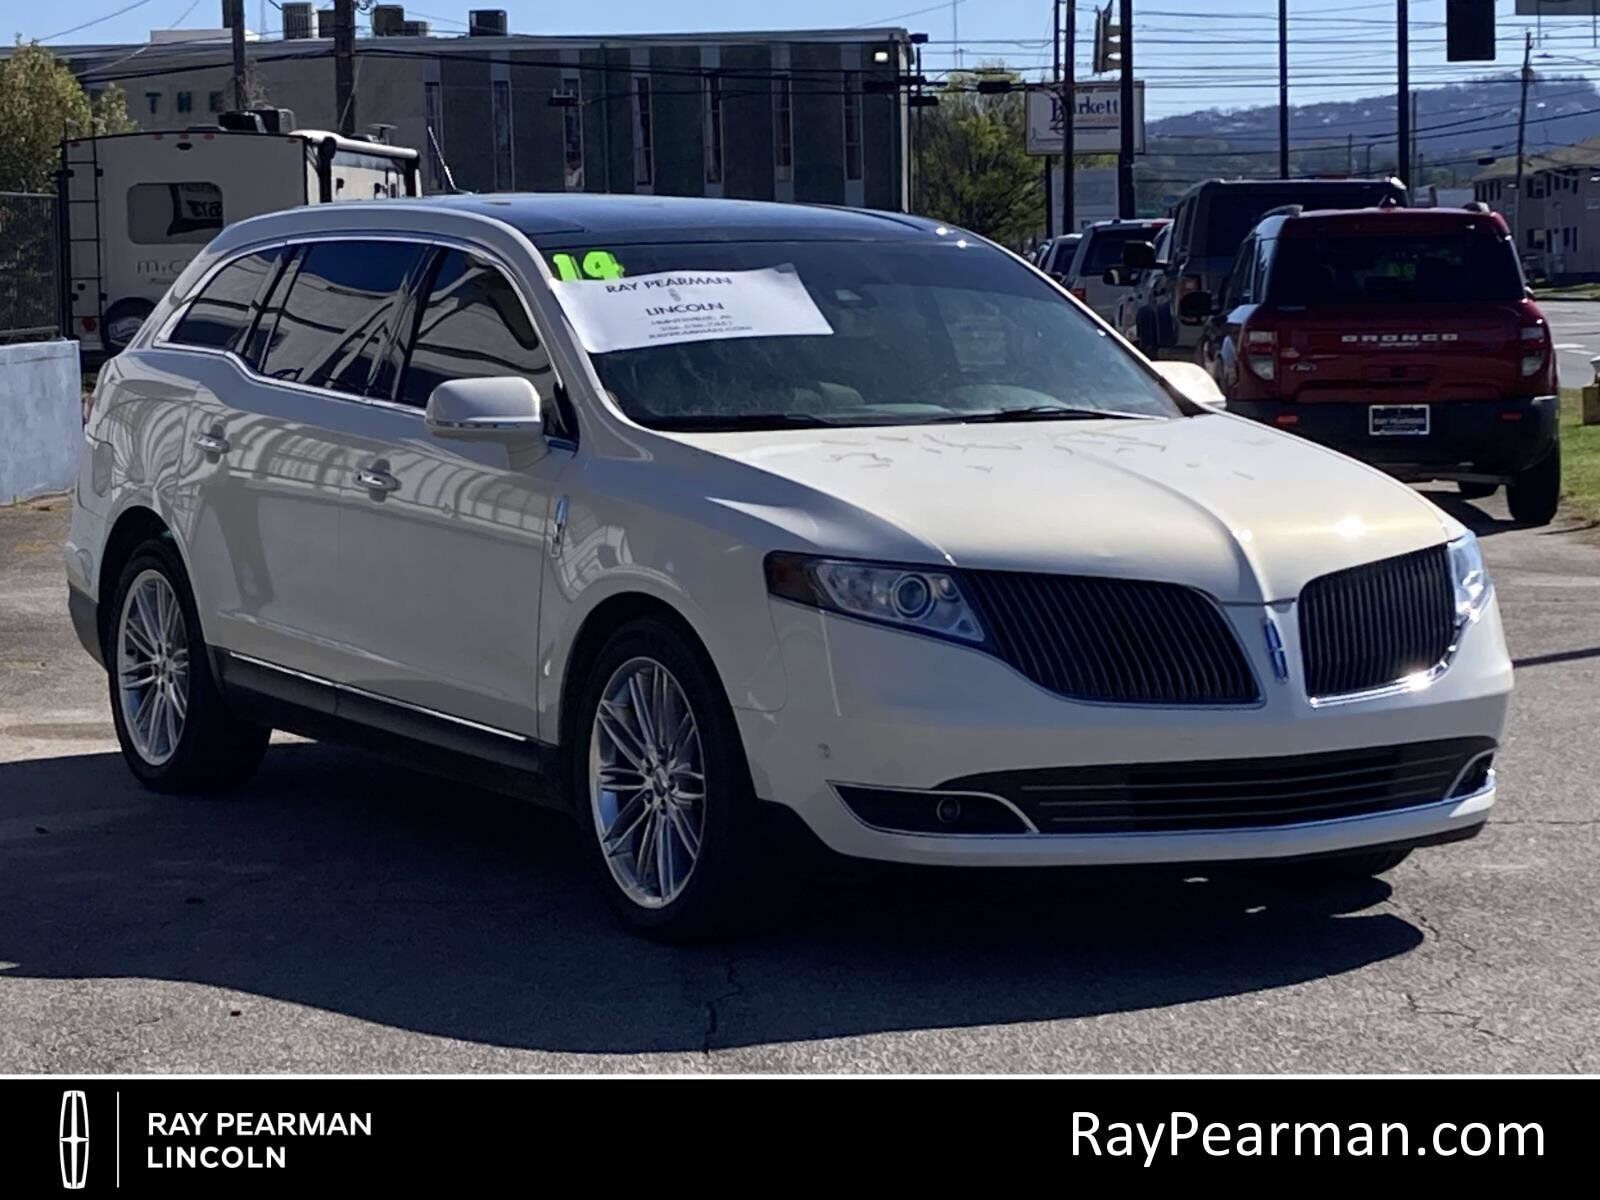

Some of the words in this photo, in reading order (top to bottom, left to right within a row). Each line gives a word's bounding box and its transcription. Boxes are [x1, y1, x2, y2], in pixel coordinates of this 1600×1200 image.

[605, 281, 638, 294] RAY
[643, 276, 732, 289] PEARMAN
[645, 301, 725, 317] LINCOLN
[1341, 333, 1459, 342] BRONCO
